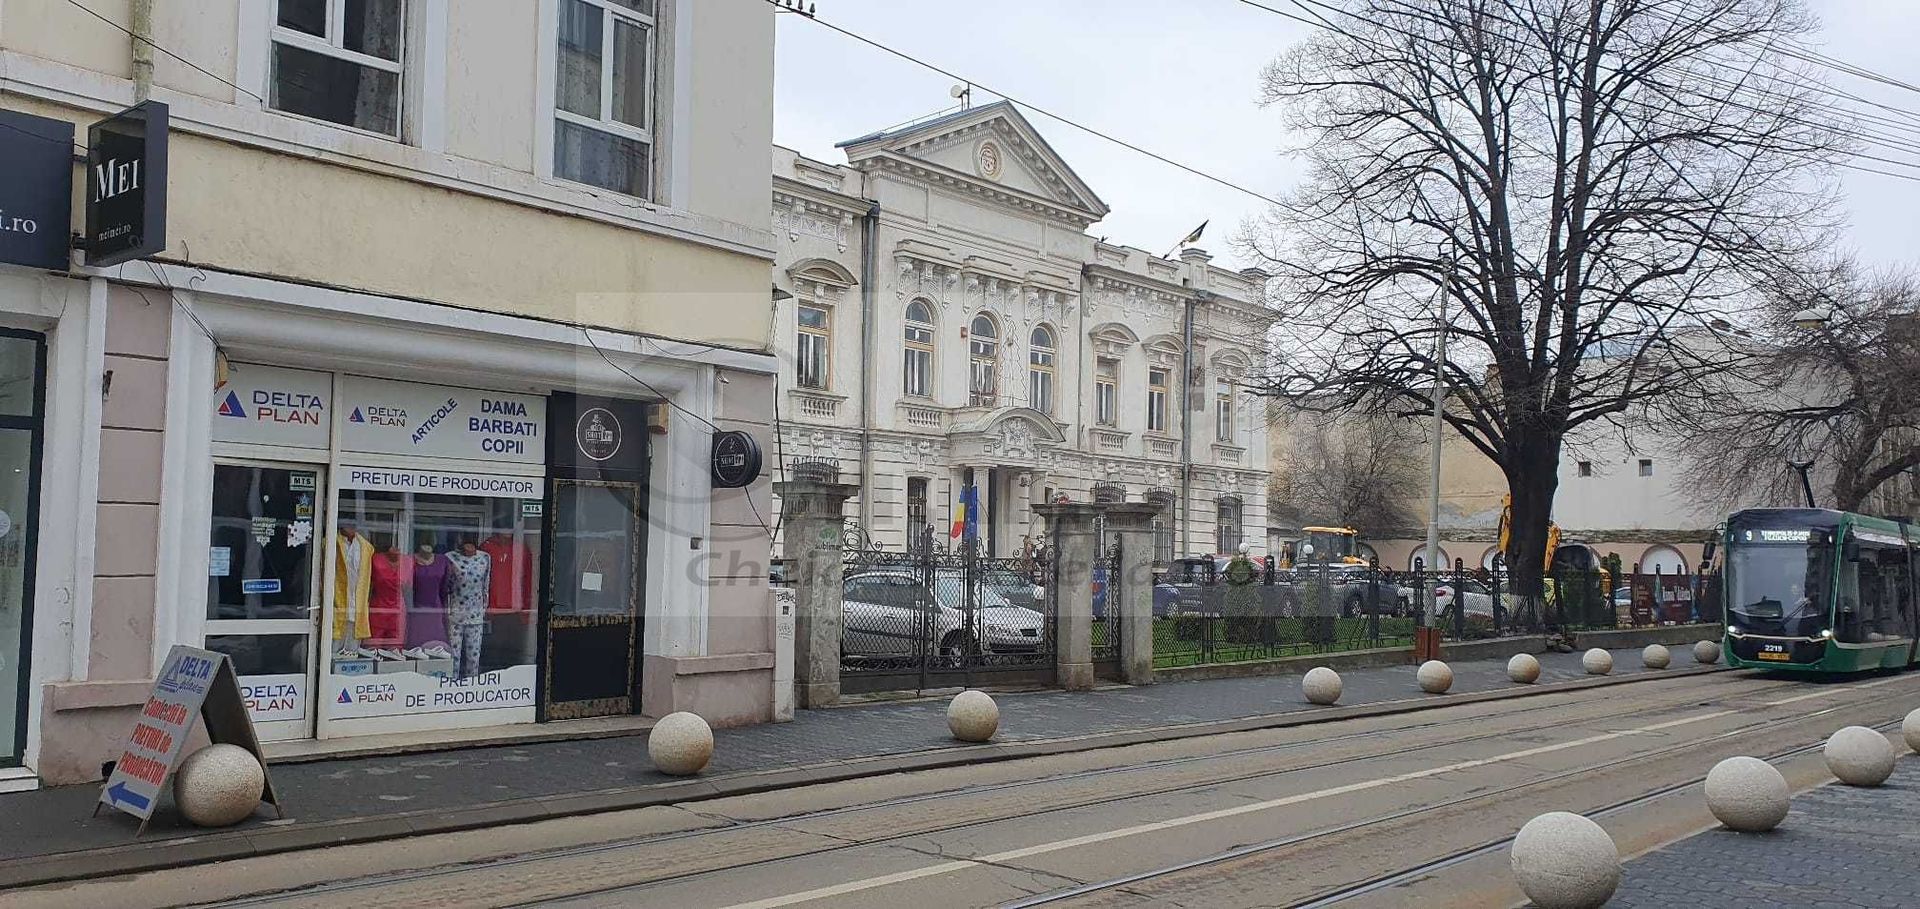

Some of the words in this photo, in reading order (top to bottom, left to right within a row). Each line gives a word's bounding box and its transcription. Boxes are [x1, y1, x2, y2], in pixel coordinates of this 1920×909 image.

[95, 159, 139, 202] MEI
[252, 390, 323, 410] DELTA
[480, 398, 527, 417] DAMA
[257, 407, 319, 425] PLAN
[367, 406, 408, 418] DELTA
[370, 416, 406, 428] PLAN
[411, 397, 458, 445] ARTICOLE
[468, 417, 537, 437] BARBATI
[481, 438, 524, 455] COPII
[351, 471, 415, 488] PRETURI
[419, 476, 438, 489] DE
[442, 477, 534, 494] PRODUCATOR
[1746, 530, 1753, 541] 9
[179, 656, 212, 680] DELTA
[439, 673, 501, 688] PRETURI
[240, 684, 298, 699] DELTA
[356, 684, 396, 695] DELTA
[358, 692, 395, 703] PLAN
[405, 694, 426, 708] DE
[434, 687, 531, 706] PRODUCATOR
[244, 698, 294, 712] PLAN
